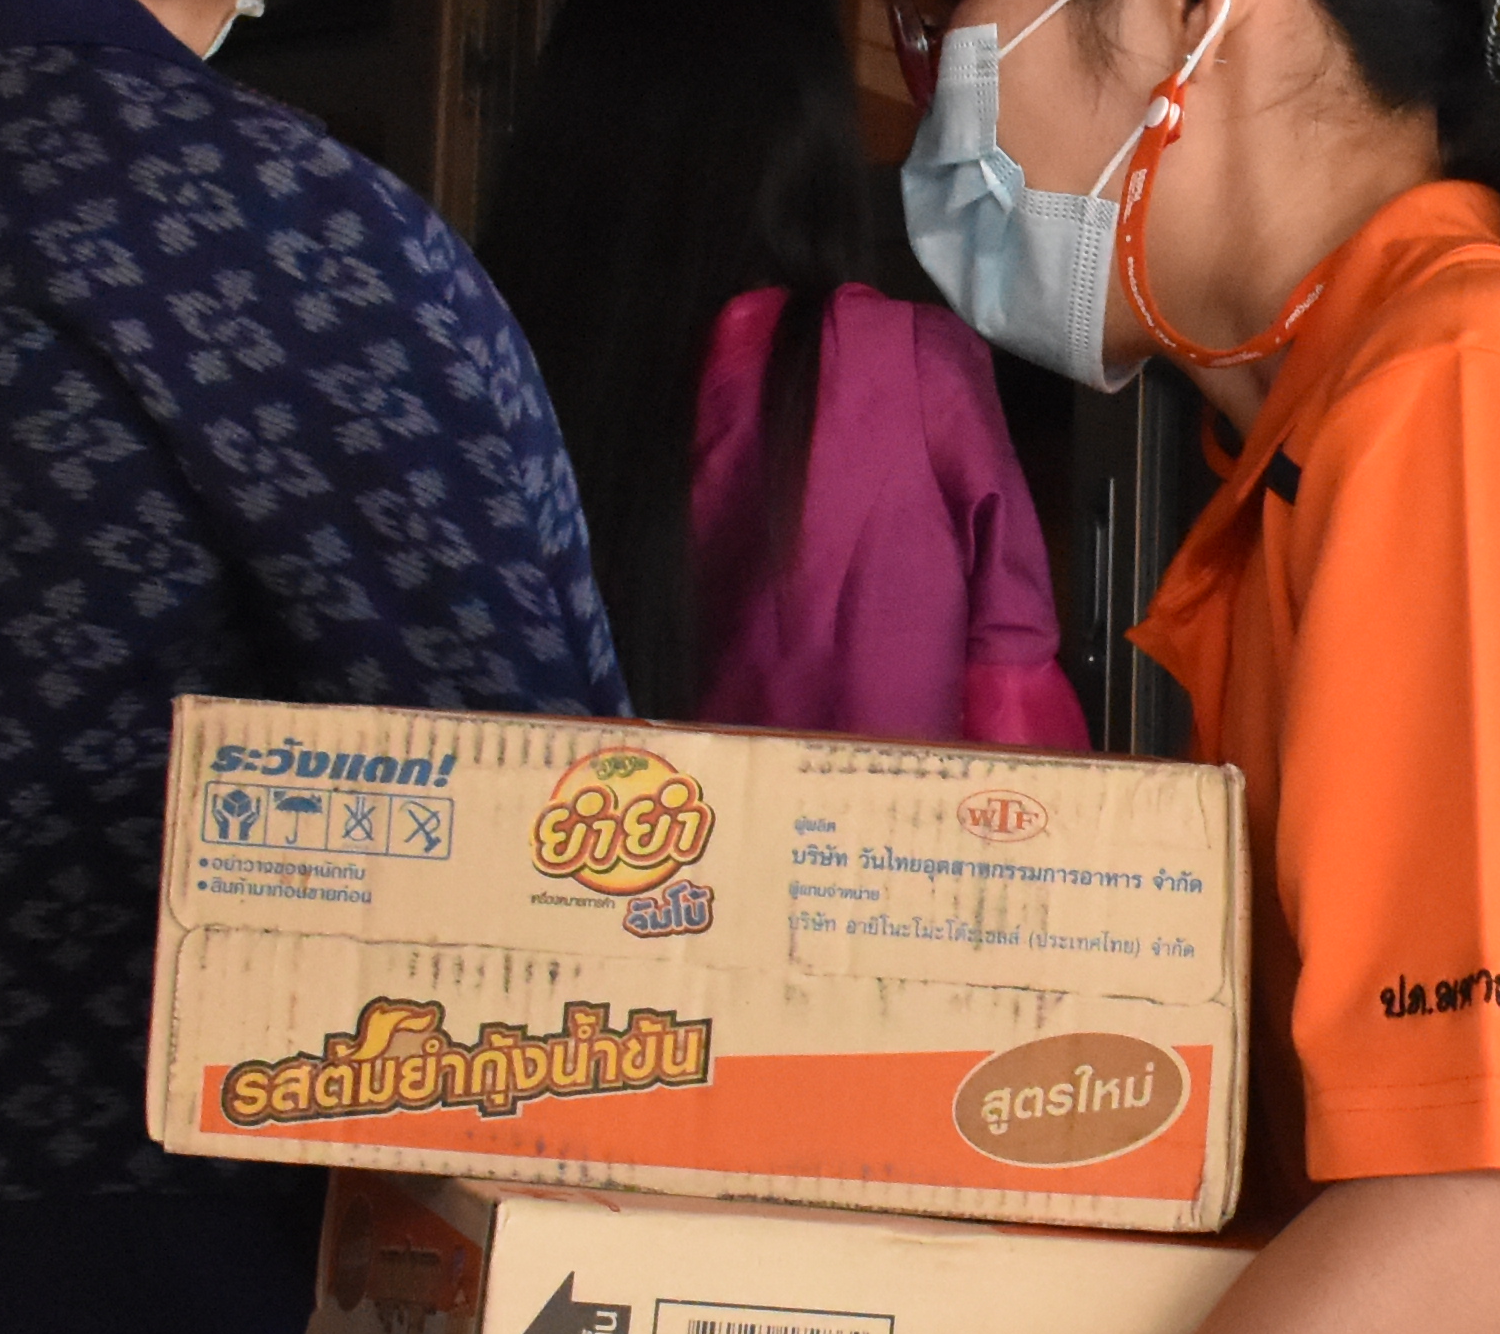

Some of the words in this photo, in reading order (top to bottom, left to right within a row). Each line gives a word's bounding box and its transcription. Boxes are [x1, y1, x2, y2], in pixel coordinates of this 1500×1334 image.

[211, 737, 457, 788] ระวังแตก!
[534, 777, 712, 875] ยำยำ
[967, 797, 1039, 834] WTF
[791, 842, 849, 867] บริษัท
[1152, 867, 1203, 894] จำกัด
[624, 880, 713, 936] จัมโบ้
[788, 911, 837, 934] บริษัท
[1028, 930, 1142, 959] (ประเทศไทย)
[1151, 936, 1196, 960] จำกัด
[981, 1061, 1155, 1135] สูตรใหม่
